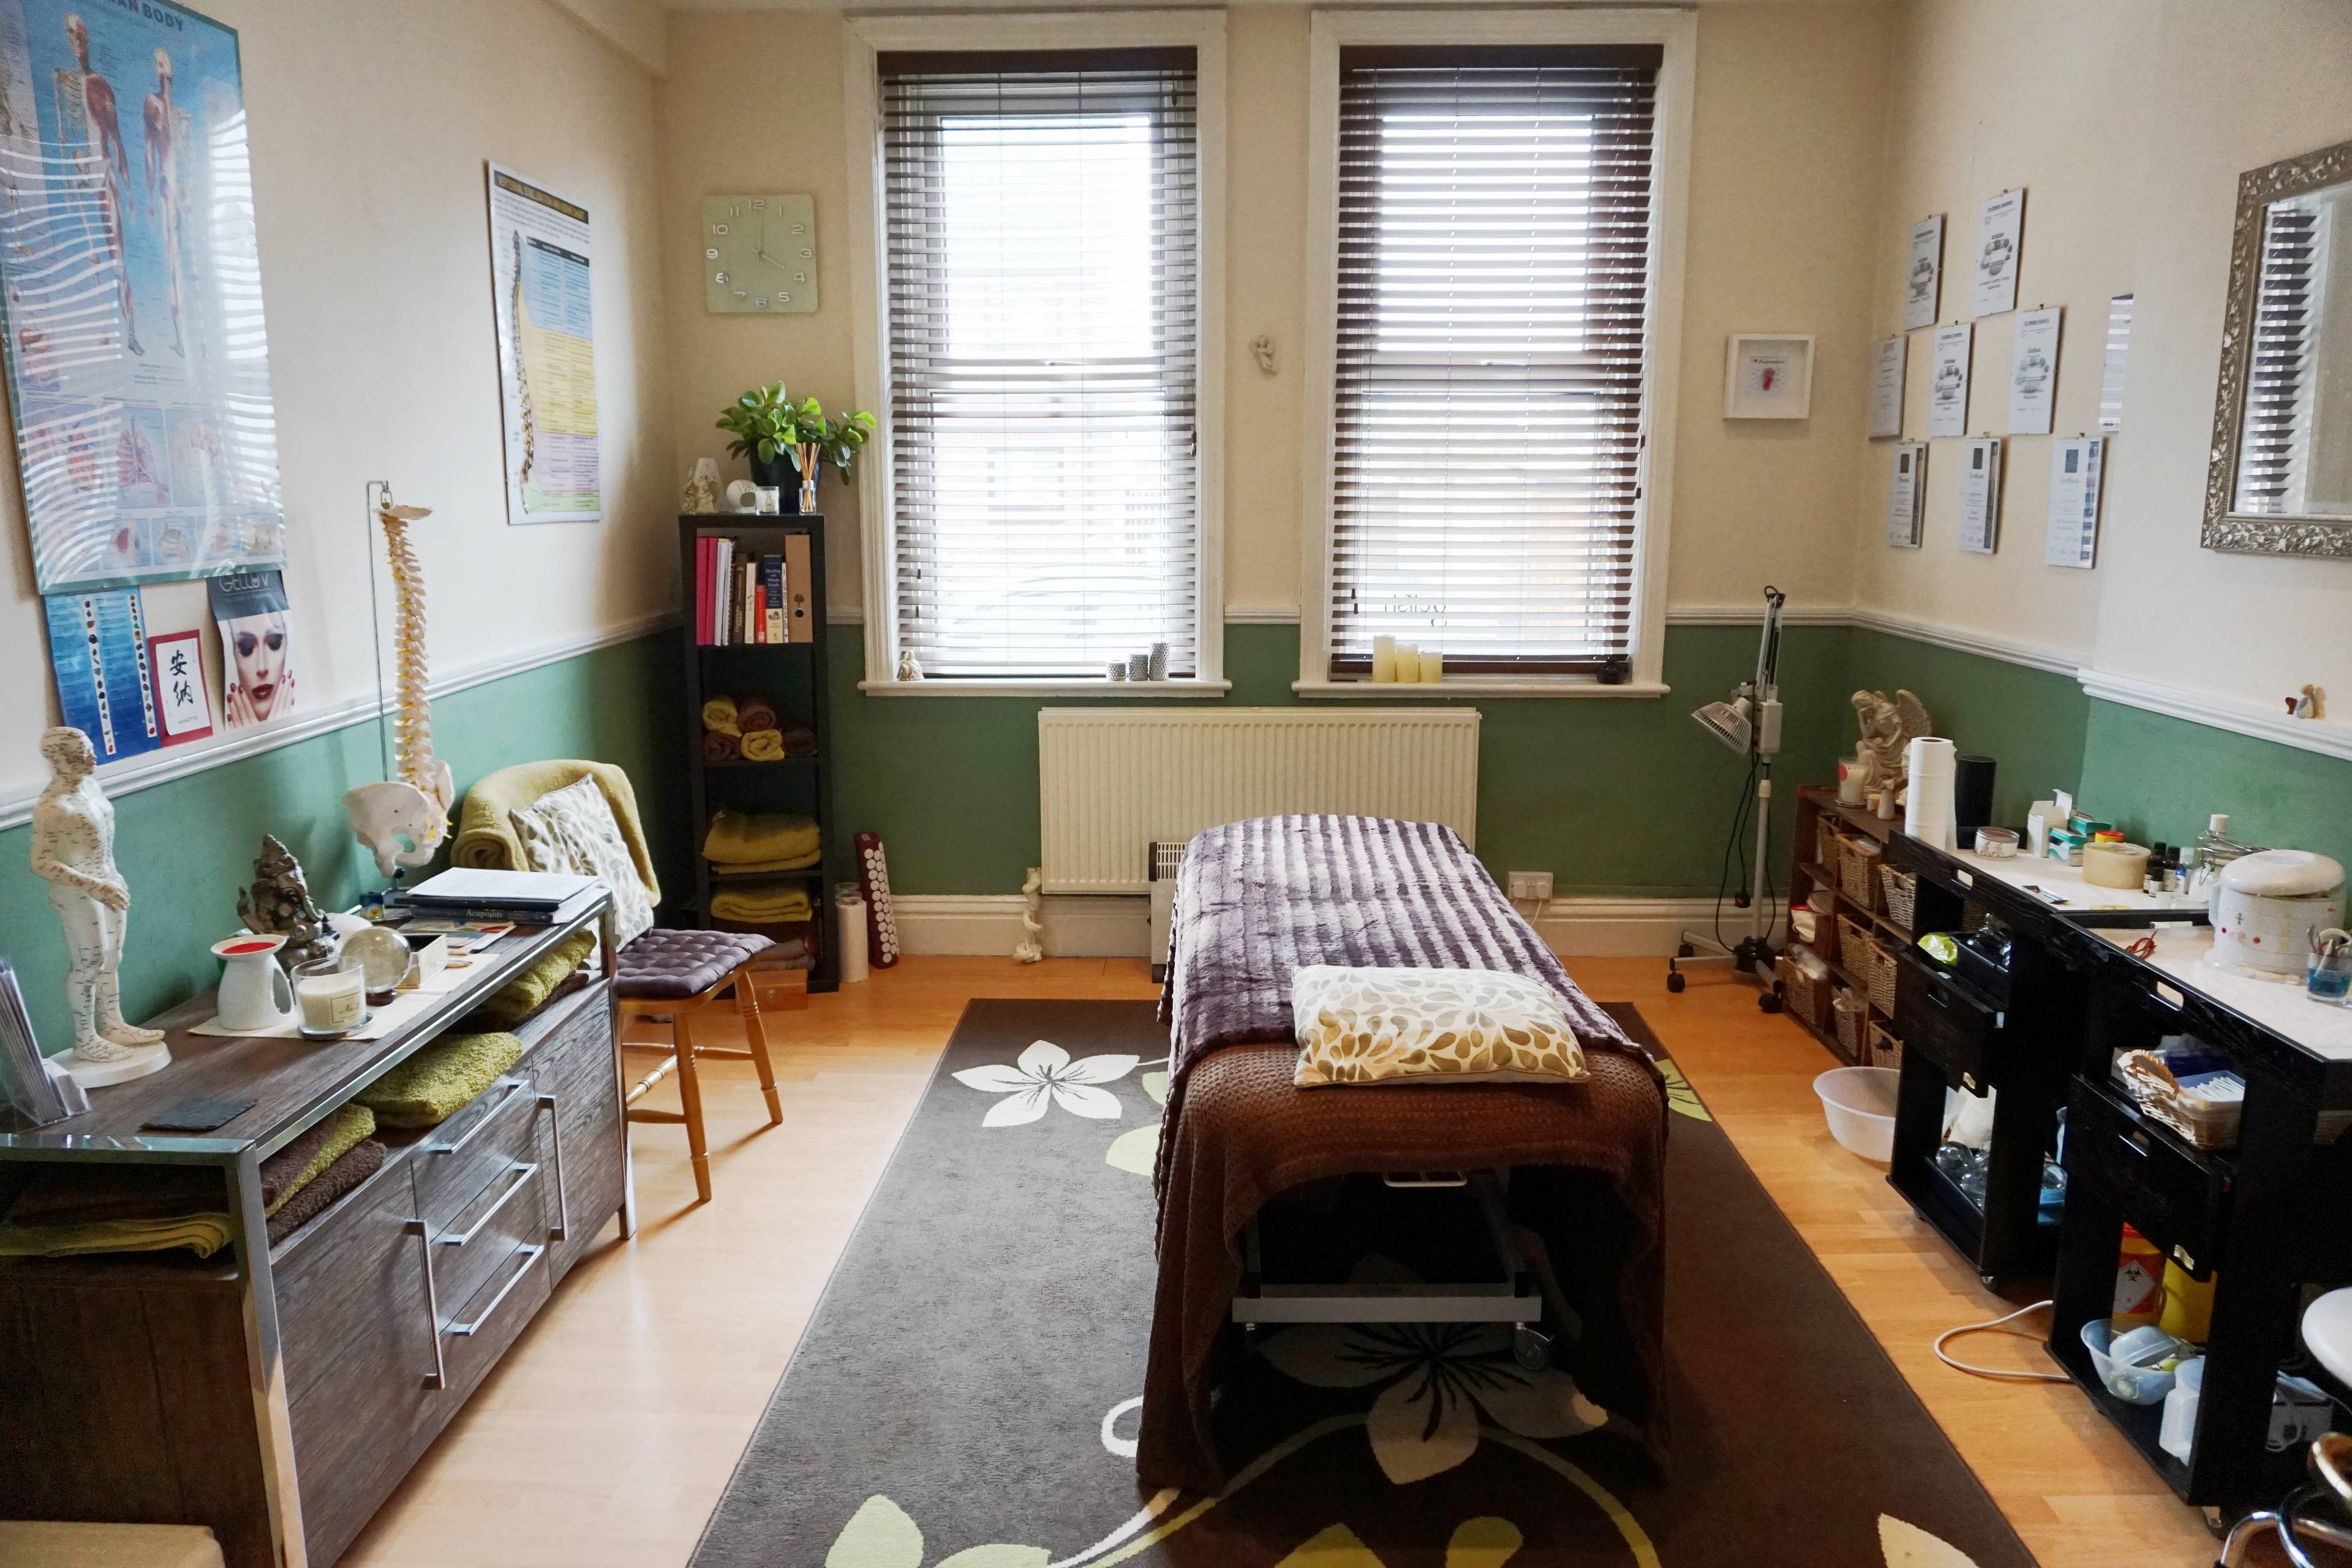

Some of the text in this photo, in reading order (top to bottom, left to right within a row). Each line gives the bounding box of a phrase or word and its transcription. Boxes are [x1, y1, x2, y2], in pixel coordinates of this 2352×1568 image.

[142, 3, 183, 31] BODY
[748, 199, 765, 210] 12
[730, 206, 739, 216] 11
[712, 224, 728, 235] 10
[791, 224, 804, 235] 2
[706, 248, 718, 258] 9
[801, 248, 812, 258] 3
[715, 273, 729, 284] 8
[794, 273, 805, 284] 4
[734, 290, 746, 299] 7
[778, 292, 790, 302] 5
[755, 297, 769, 307] 6
[466, 909, 503, 919] Acupoints
